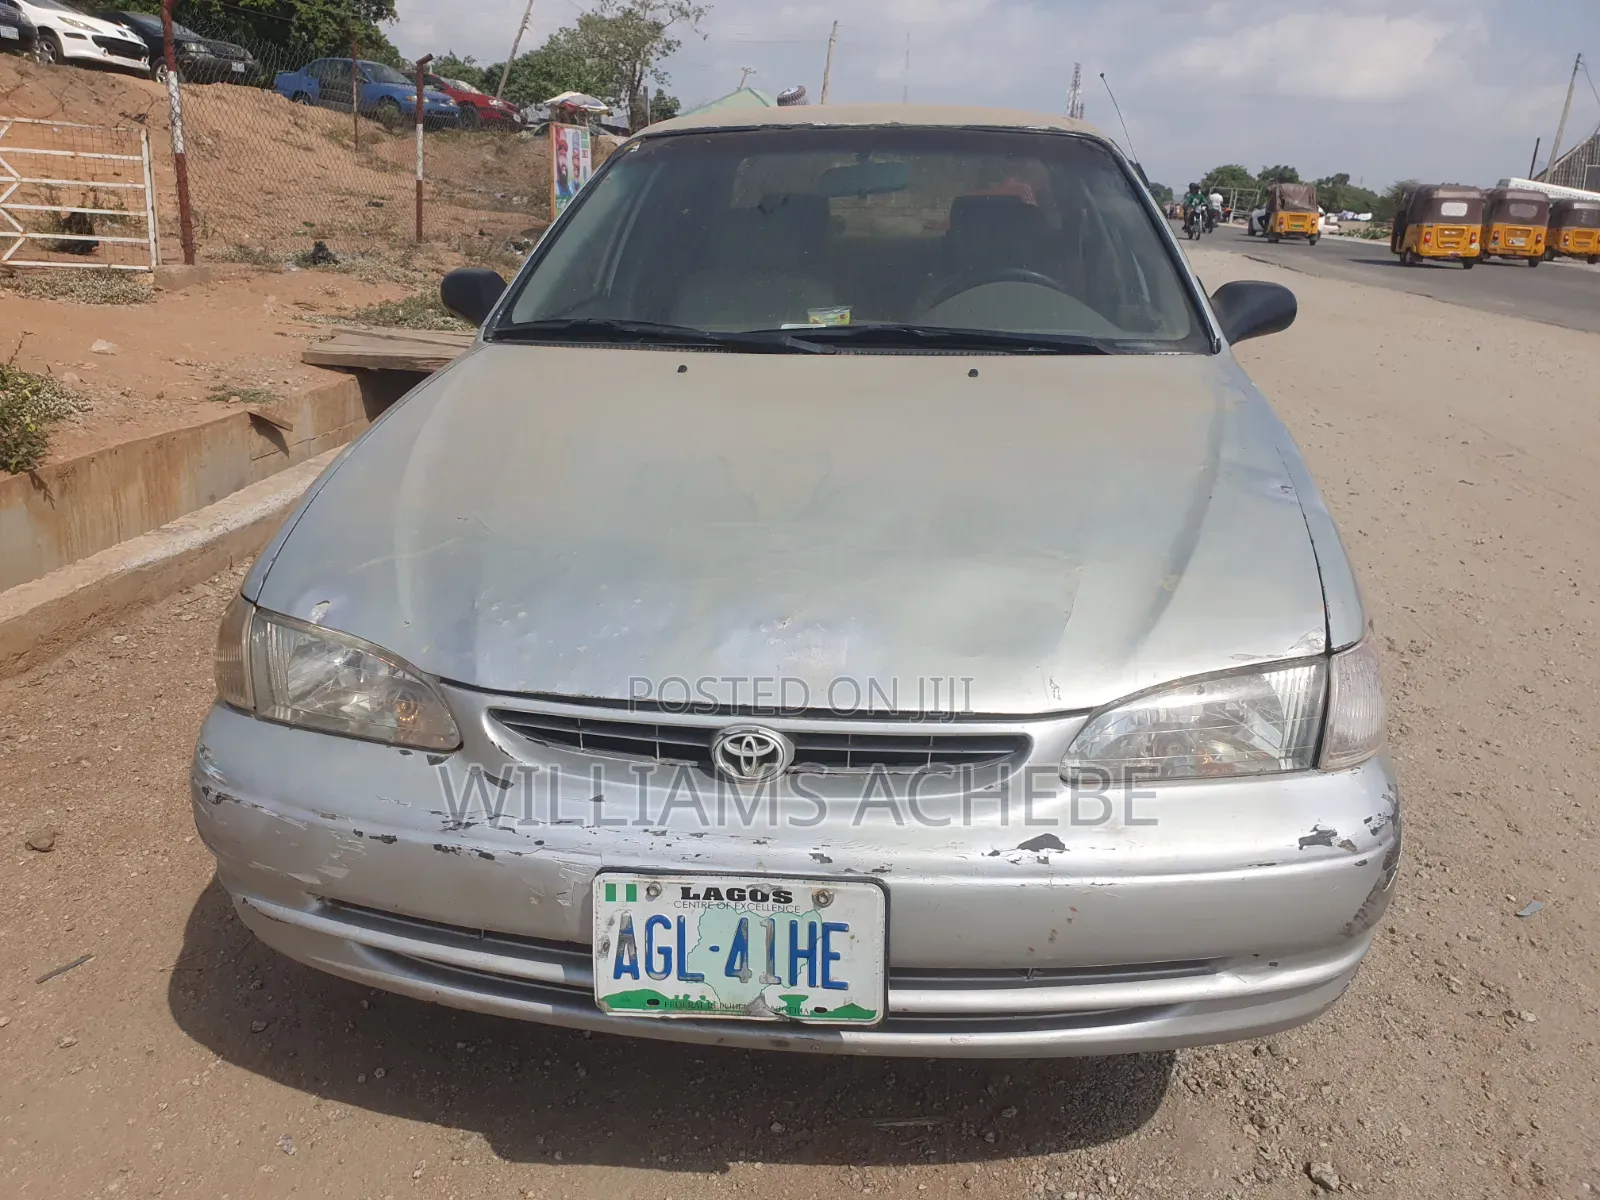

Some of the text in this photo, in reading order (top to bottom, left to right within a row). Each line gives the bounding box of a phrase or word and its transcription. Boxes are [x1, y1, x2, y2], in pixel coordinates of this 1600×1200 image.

[680, 886, 793, 904] LAGOS
[673, 900, 801, 914] CENTRE OF EXCELLENCE
